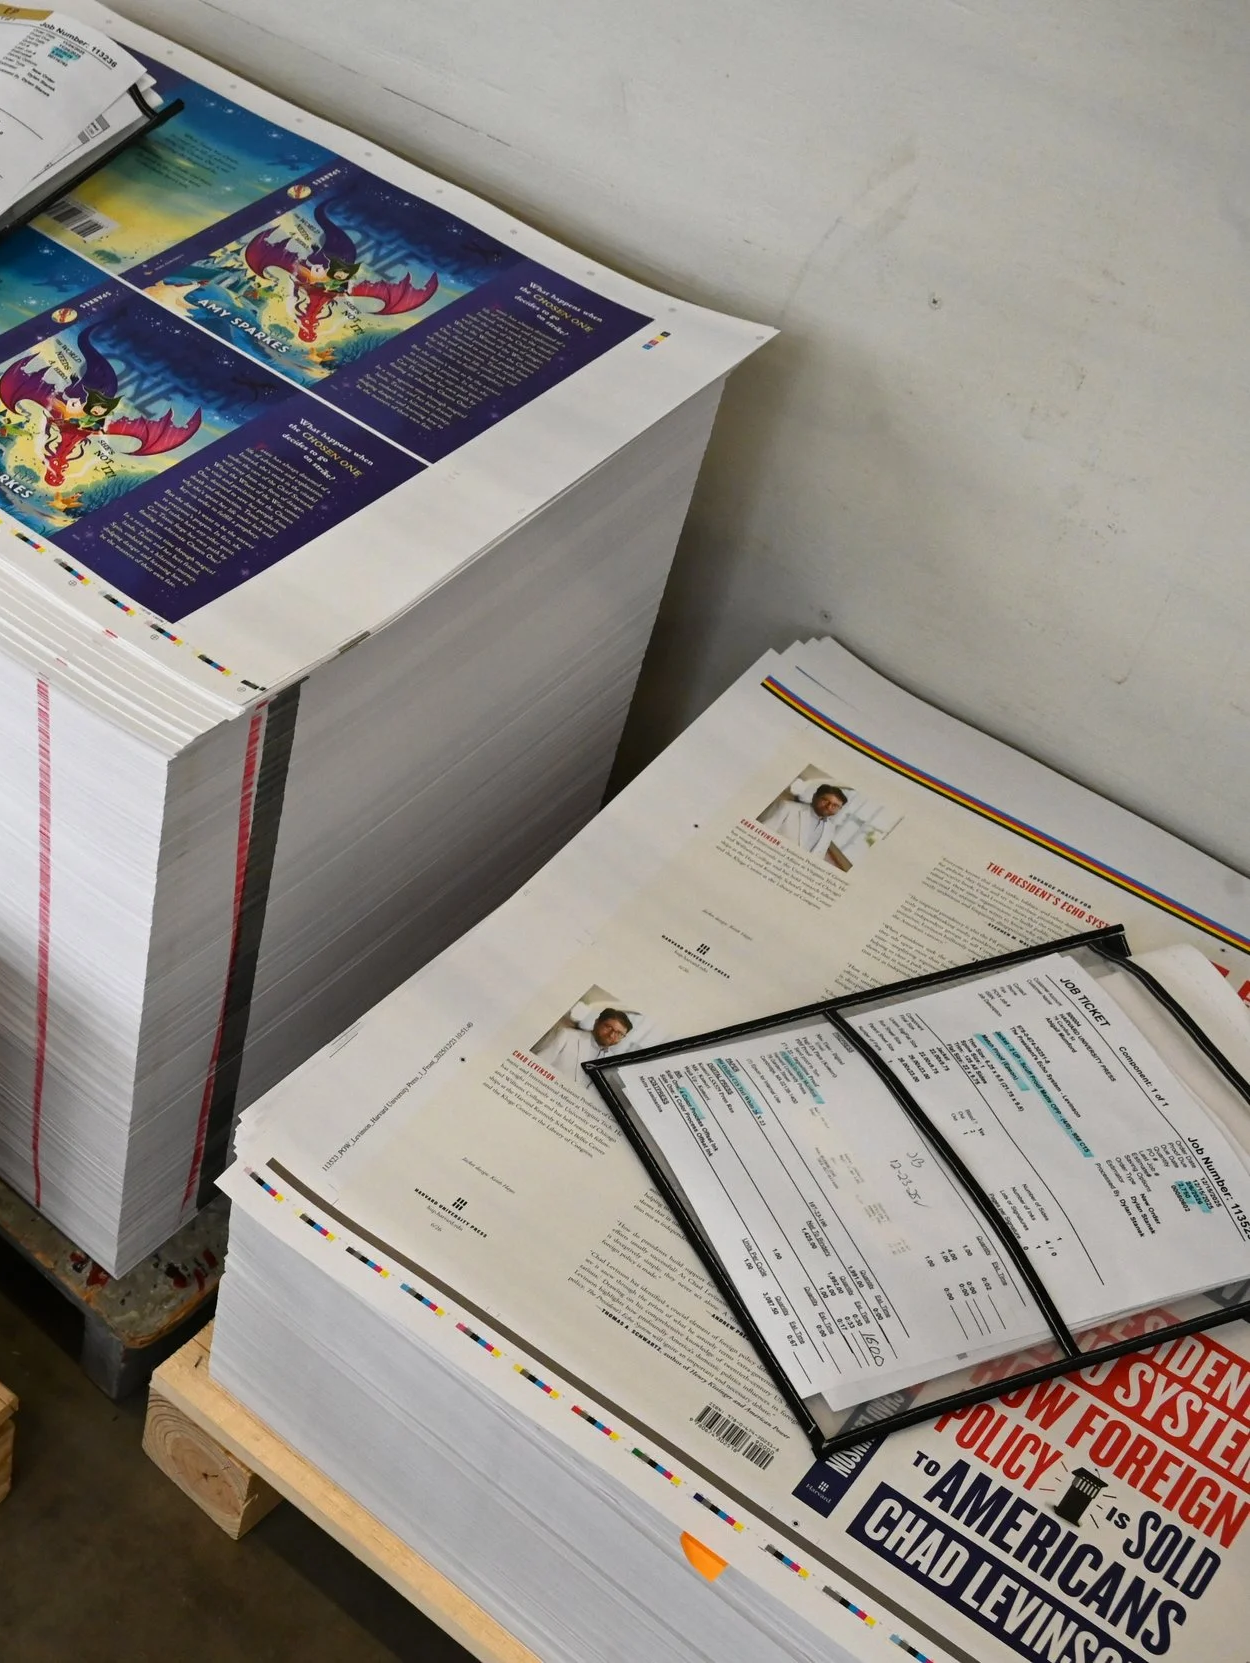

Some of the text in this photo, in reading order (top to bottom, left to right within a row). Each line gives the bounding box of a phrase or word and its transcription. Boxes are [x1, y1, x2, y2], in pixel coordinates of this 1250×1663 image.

[39, 21, 55, 33] Job
[55, 27, 90, 49] Number:
[78, 290, 112, 310] SPARKES
[514, 295, 540, 311] decides
[530, 281, 603, 323] What happens when
[533, 294, 571, 319] CHOSEN
[571, 317, 594, 333] ONE
[197, 298, 292, 354] AMY SPARKES
[545, 319, 569, 336] strike?
[93, 449, 115, 467] NOT
[282, 432, 309, 451] decides
[288, 423, 363, 478] the CHOSEN ONE
[299, 417, 374, 467] What happens when
[312, 461, 336, 481] strike?
[986, 861, 1003, 877] THE
[1004, 872, 1062, 906] PRESIDENT'S
[1059, 901, 1086, 919] ECHO
[661, 934, 684, 951] HARVARD
[684, 949, 714, 969] UNIVERSITY
[1059, 977, 1109, 1027] JOB TICKET
[511, 1050, 557, 1082] CHAD LEVINSON
[1118, 1047, 1152, 1087] Component:
[1187, 1136, 1205, 1156] Job
[1202, 1156, 1234, 1201] Number:
[414, 1187, 440, 1206] HARVARD
[438, 1203, 471, 1227] UNIVERSITY
[469, 1224, 489, 1239] PRESS
[1129, 1196, 1156, 1234] Dylan Stanek
[1147, 1207, 1161, 1224] Order
[1113, 1361, 1250, 1479] SYSTE
[805, 1483, 832, 1504] Harvard
[1065, 1403, 1250, 1550] FOREIGN
[863, 1497, 970, 1588] CHAD
[912, 1450, 1222, 1657] TO AMERICANS IS SOLD
